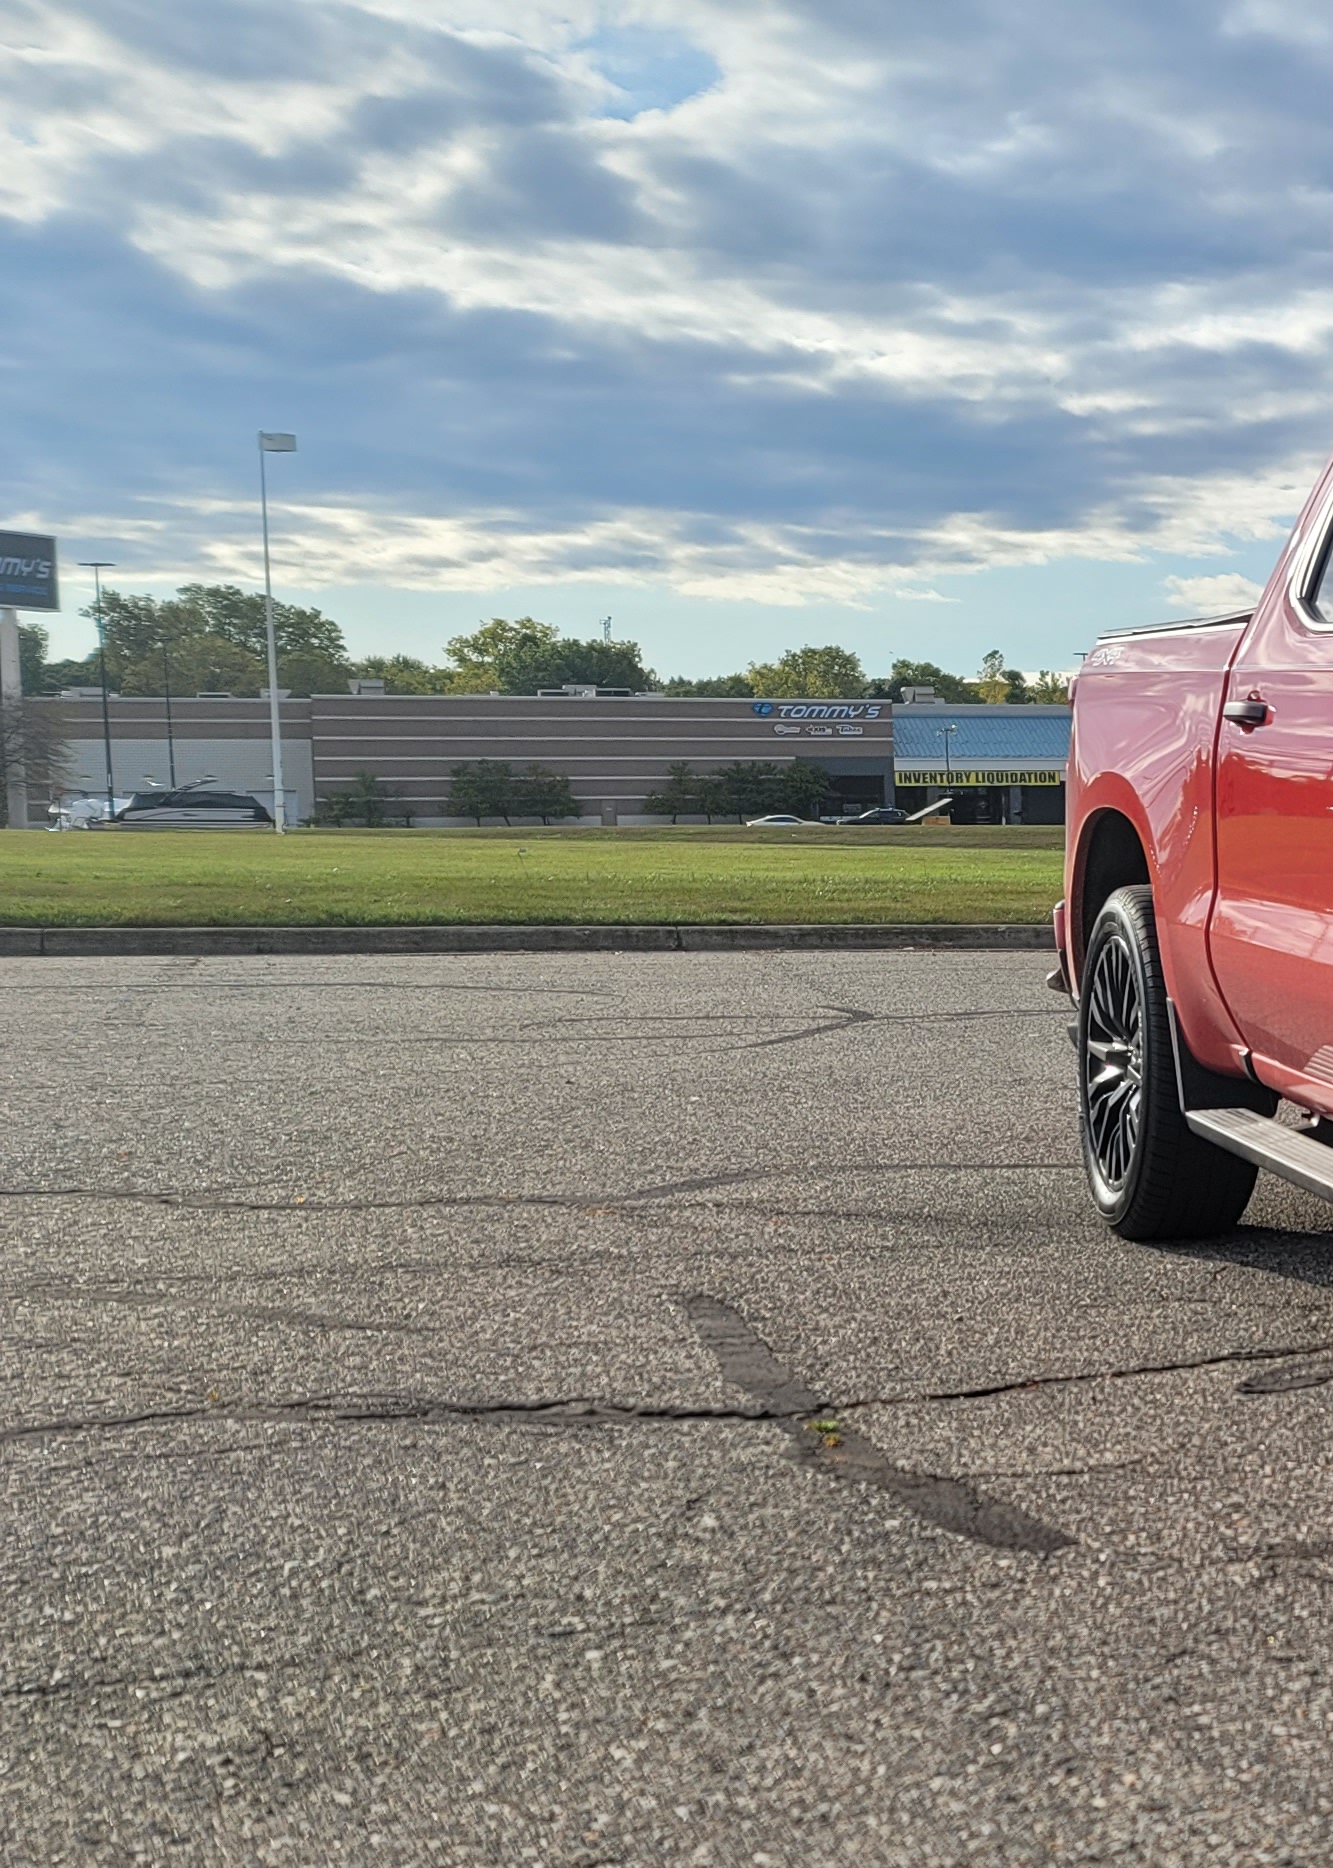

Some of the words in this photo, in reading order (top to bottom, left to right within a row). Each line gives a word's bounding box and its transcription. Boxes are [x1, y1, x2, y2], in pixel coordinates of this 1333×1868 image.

[777, 704, 882, 719] TOMMY'S
[898, 771, 972, 784] INVENTORY
[975, 771, 1057, 784] LIQUIDATION
